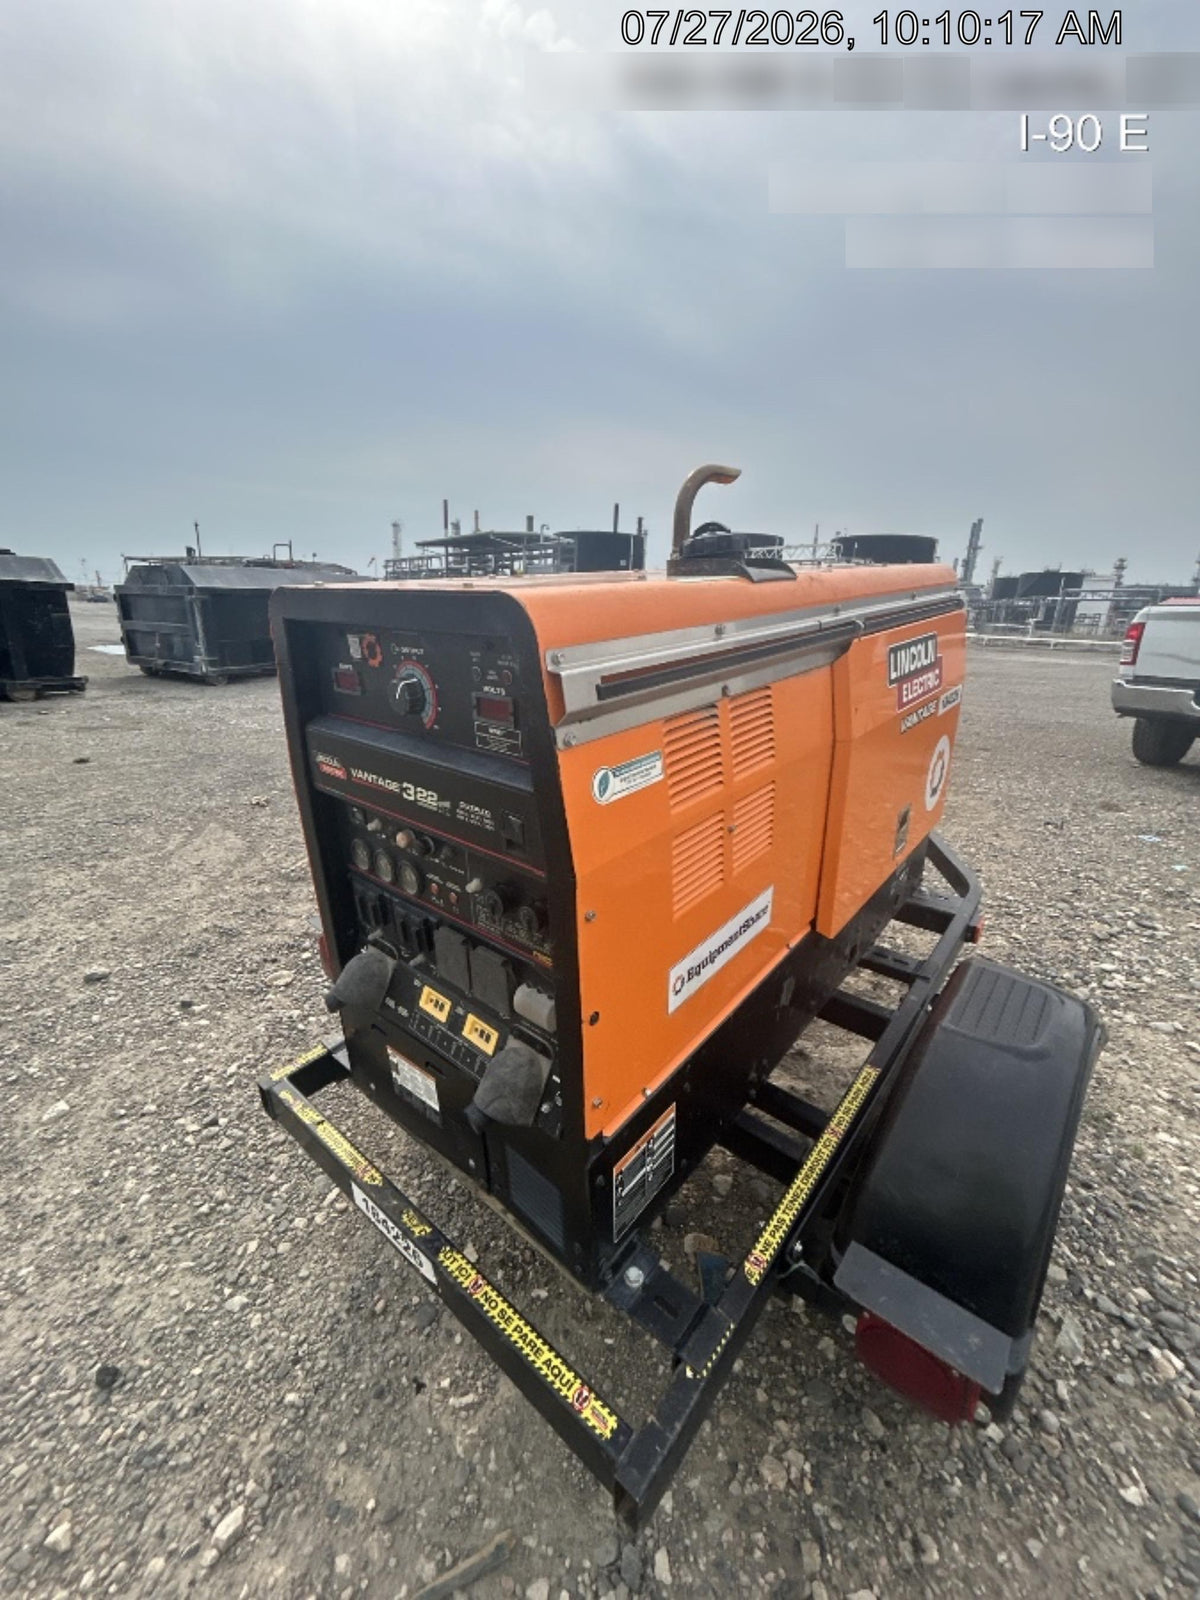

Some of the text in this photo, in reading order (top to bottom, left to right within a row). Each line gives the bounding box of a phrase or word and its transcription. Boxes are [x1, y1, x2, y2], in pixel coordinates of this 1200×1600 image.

[890, 639, 936, 681] LINCOLN
[902, 668, 940, 703] ELECTRIC
[350, 767, 401, 793] VANTAGE
[402, 782, 439, 807] 322
[768, 1217, 786, 1239] PAS
[454, 1263, 472, 1281] ICI
[481, 1290, 499, 1310] NO
[497, 1308, 515, 1328] SE
[511, 1324, 545, 1359] PARE
